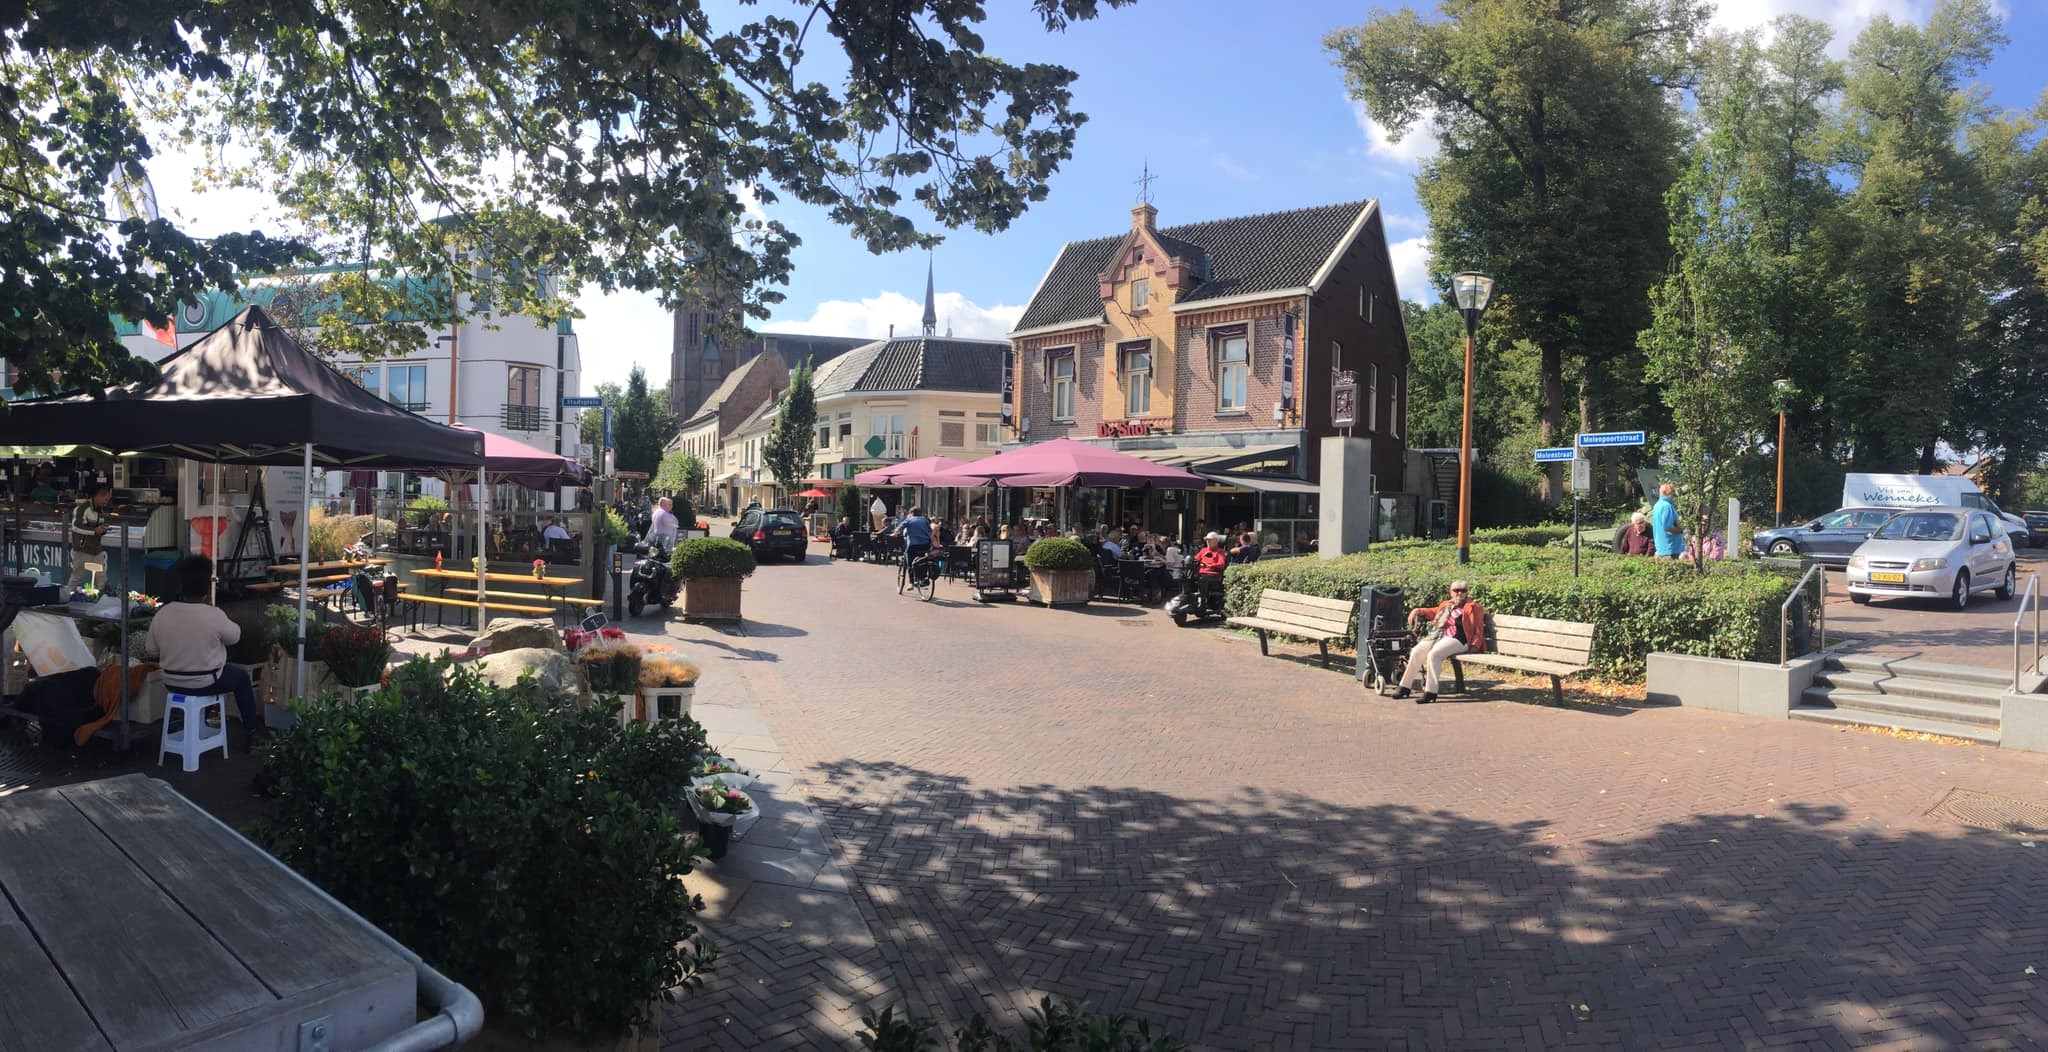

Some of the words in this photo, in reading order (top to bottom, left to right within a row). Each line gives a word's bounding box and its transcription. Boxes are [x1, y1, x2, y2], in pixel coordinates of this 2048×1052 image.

[1117, 421, 1150, 437] Snor
[1583, 435, 1640, 444] Molenpoortstraat
[1536, 451, 1573, 459] Molenstraat
[1863, 492, 1940, 505] Wennekes
[22, 544, 40, 565] VIS
